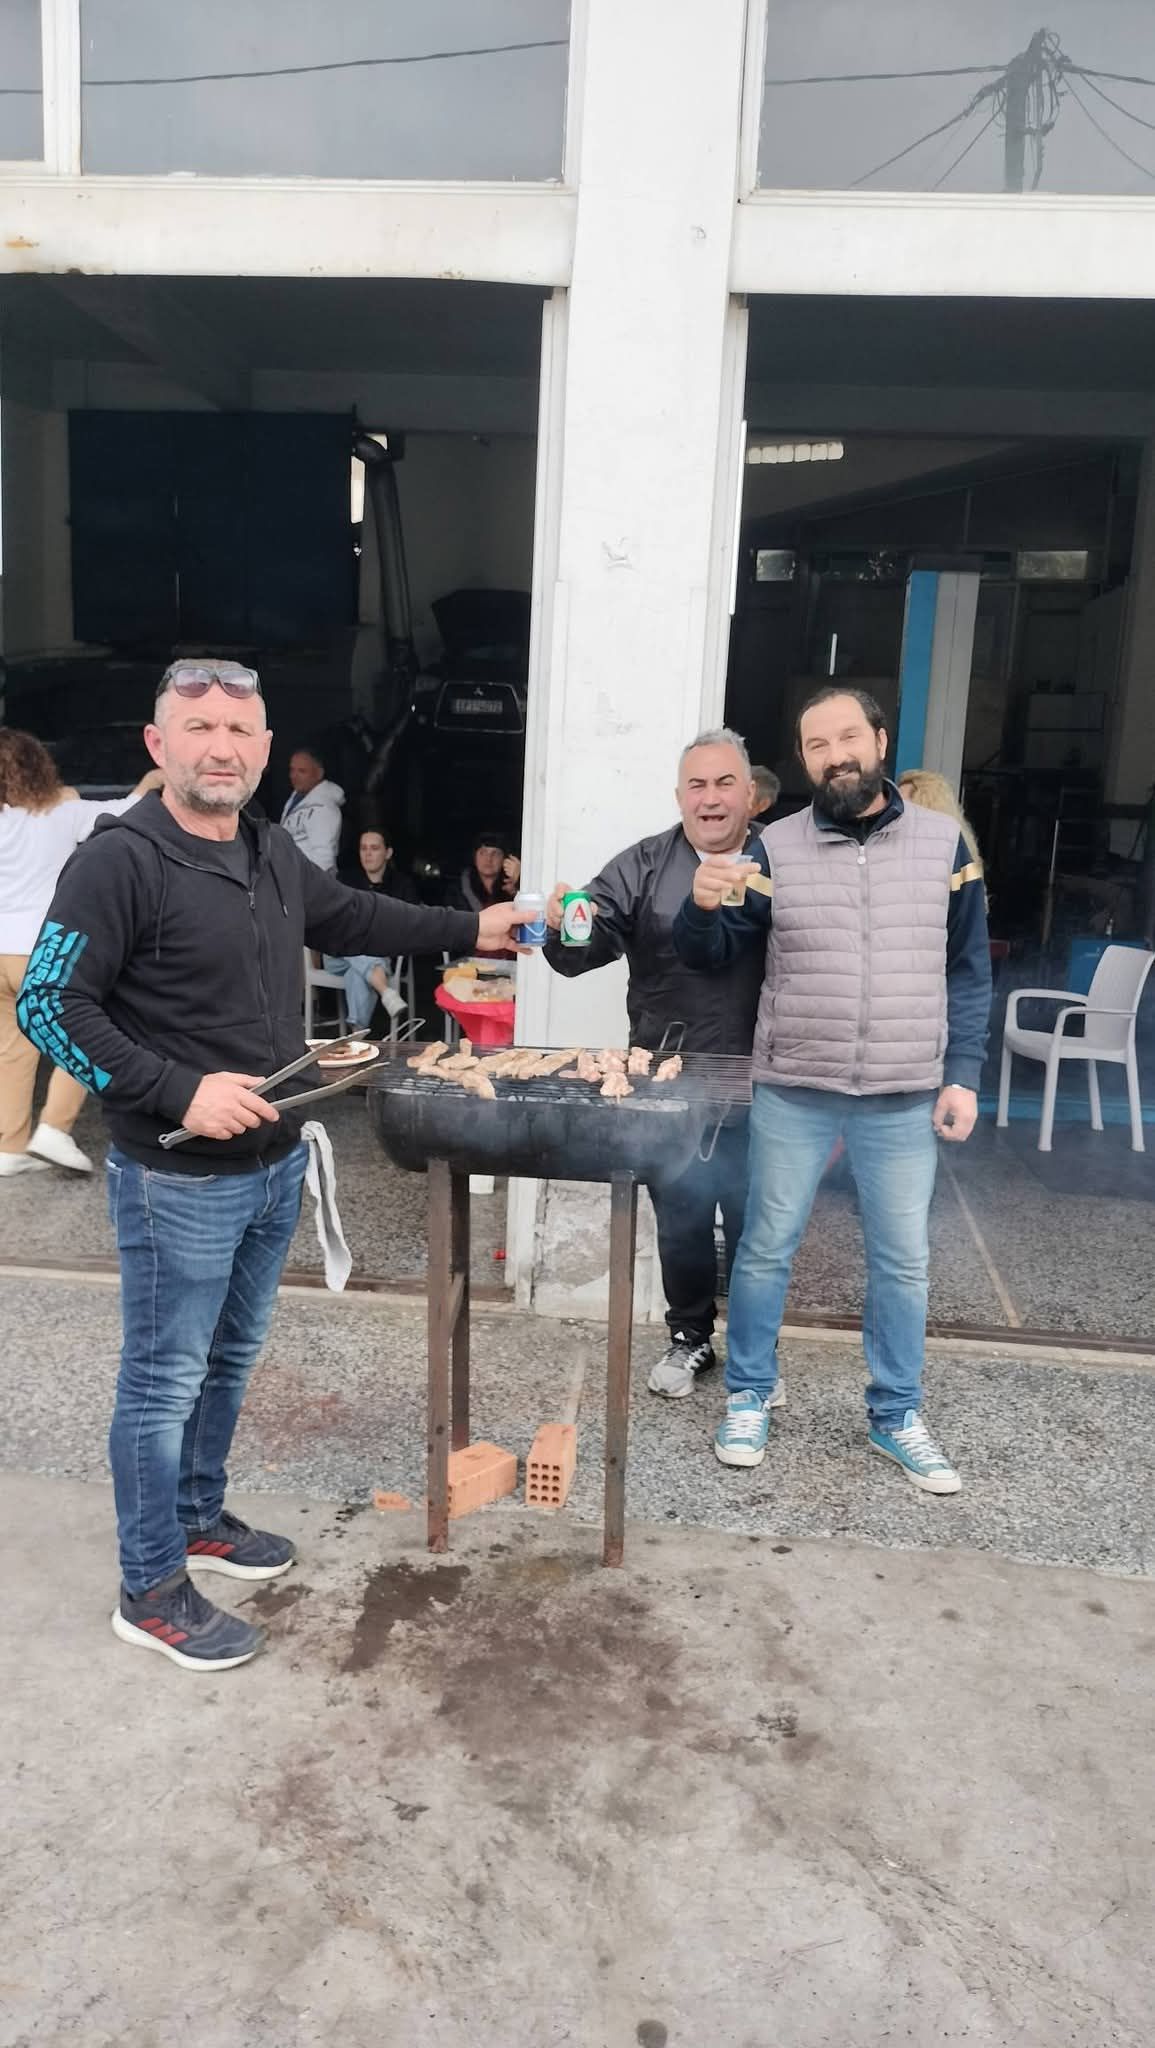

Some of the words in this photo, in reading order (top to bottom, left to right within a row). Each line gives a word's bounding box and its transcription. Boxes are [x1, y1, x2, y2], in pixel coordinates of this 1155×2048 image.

[571, 903, 587, 922] A
[27, 934, 63, 1009] DISION
[31, 1013, 92, 1082] FITNESS
